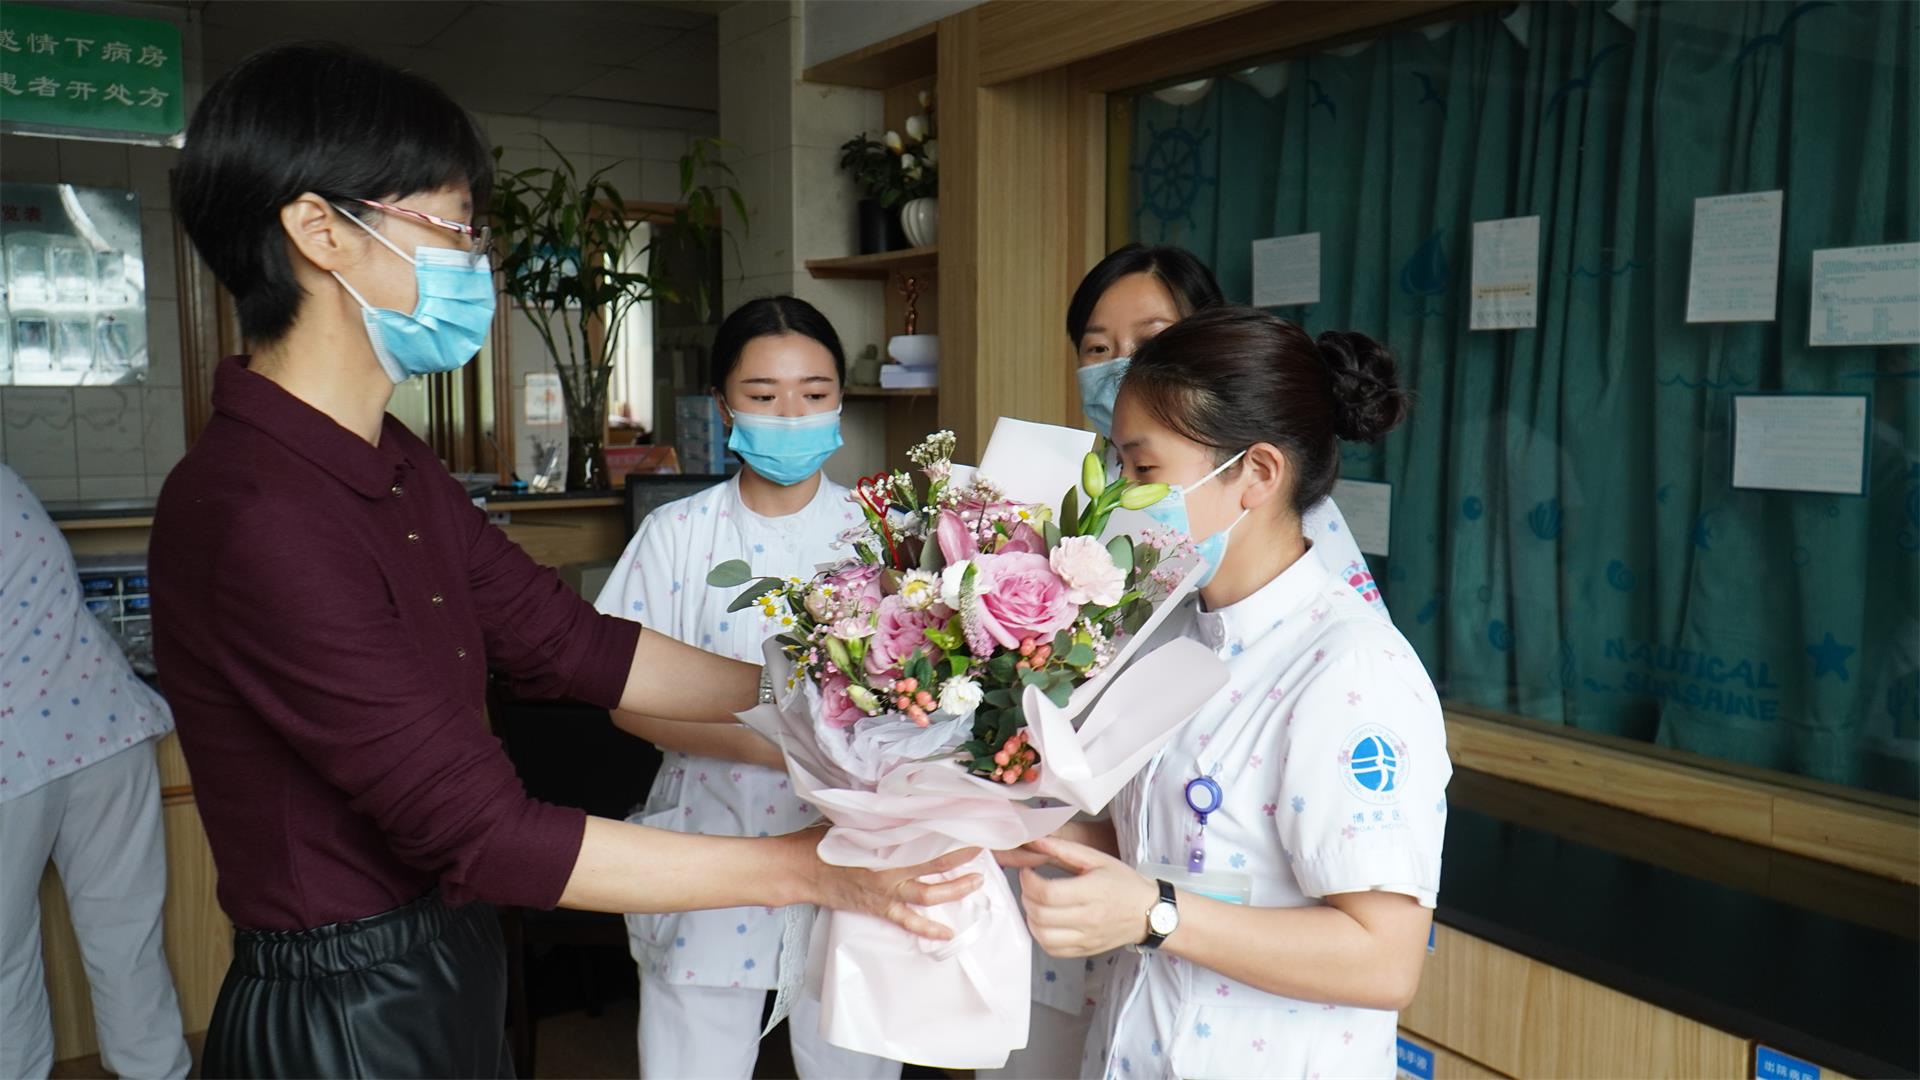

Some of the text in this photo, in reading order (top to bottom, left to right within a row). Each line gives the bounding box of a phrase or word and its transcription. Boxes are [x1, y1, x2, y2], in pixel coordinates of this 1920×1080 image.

[0, 72, 169, 107] 患者开处方
[1604, 637, 1780, 690] NAUTICAL
